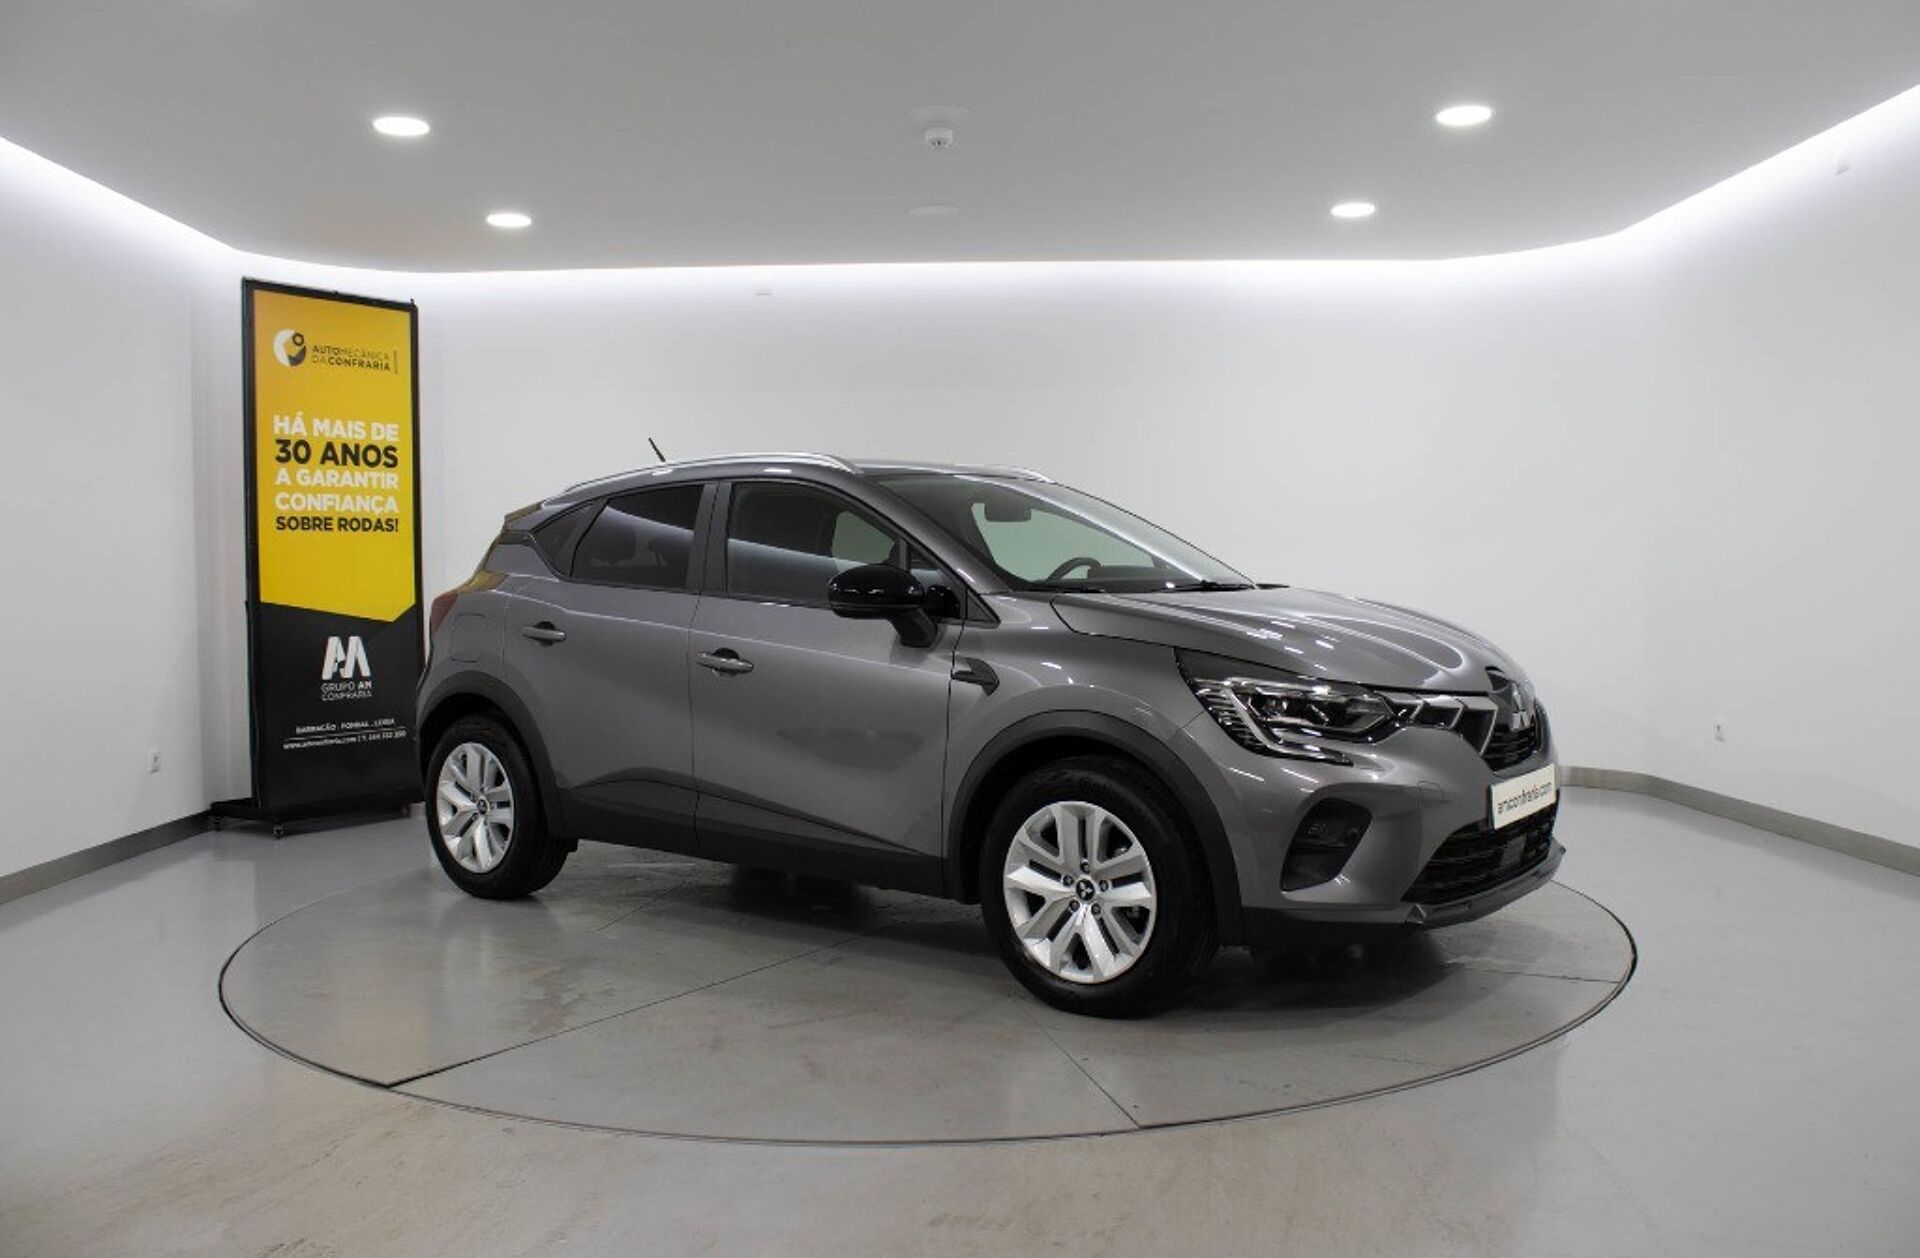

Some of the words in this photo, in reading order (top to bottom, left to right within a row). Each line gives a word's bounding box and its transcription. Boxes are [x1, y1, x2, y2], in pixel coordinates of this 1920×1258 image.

[273, 411, 307, 436] HÁ
[313, 418, 366, 439] MAIS
[371, 422, 399, 442] DE
[275, 439, 312, 465] 30
[320, 441, 399, 468] ANOS
[275, 468, 291, 486] A
[296, 469, 399, 489] GARANTIR
[275, 492, 399, 515] CONFIANÇA
[276, 516, 333, 531] SOBRE
[338, 517, 399, 532] RODAS!
[321, 681, 355, 694] GRUPO
[357, 681, 372, 690] AM
